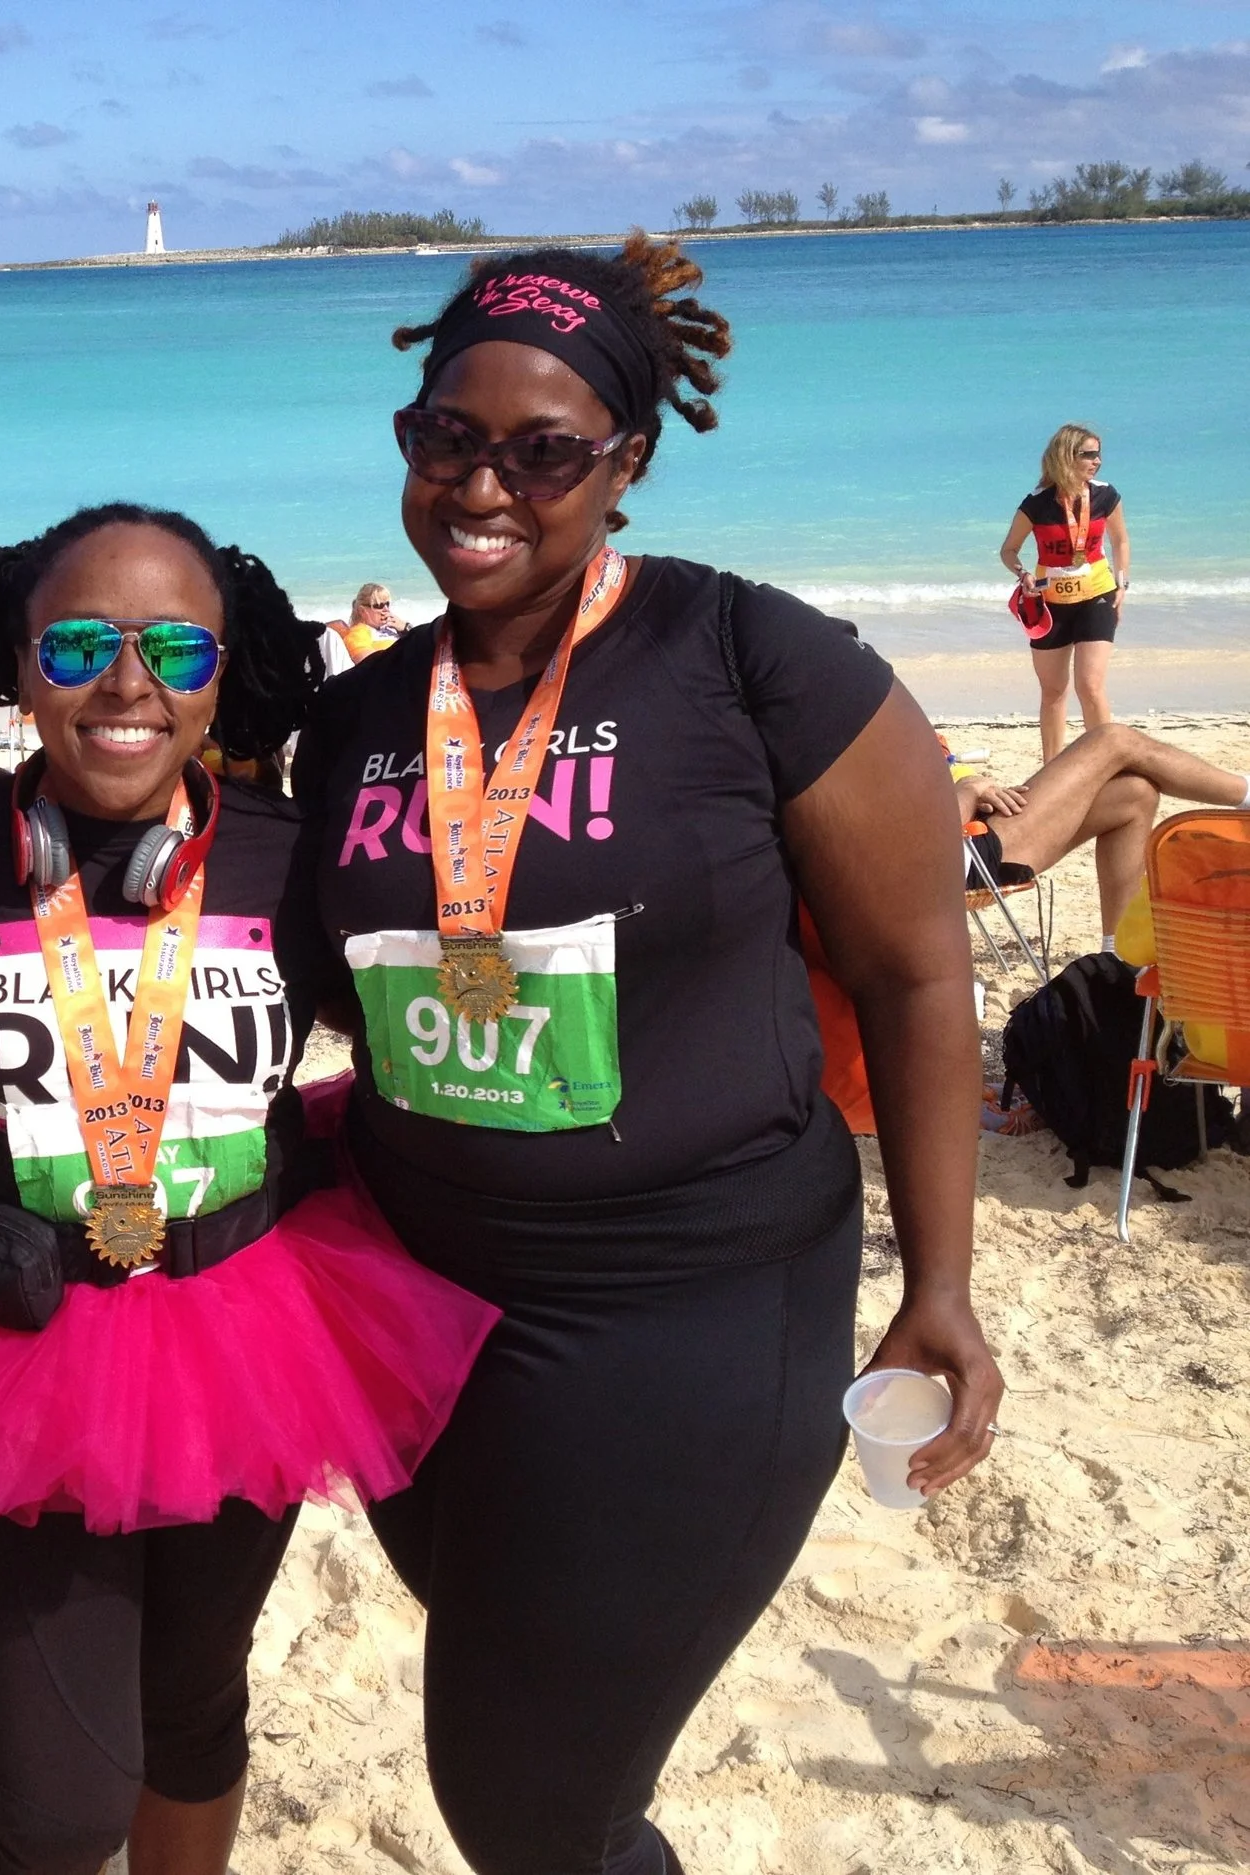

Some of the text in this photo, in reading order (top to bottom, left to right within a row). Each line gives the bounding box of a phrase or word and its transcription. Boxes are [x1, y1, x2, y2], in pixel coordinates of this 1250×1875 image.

[488, 286, 586, 333] Sexy
[1055, 580, 1081, 593] 661
[494, 720, 618, 764] RLS
[445, 754, 454, 790] Assurance
[454, 754, 464, 788] RoyalStar
[486, 787, 531, 802] 2013
[448, 821, 464, 852] John
[441, 899, 486, 918] 2013
[157, 941, 169, 981] Assurance
[440, 941, 499, 950] Sunshine
[62, 955, 75, 993] Assurance
[70, 952, 83, 989] RoyalStar
[190, 966, 282, 1000] IRLS
[141, 1014, 163, 1079] John Bull
[405, 996, 551, 1075] 907
[78, 1025, 105, 1089] John Bull
[431, 1082, 525, 1105] 1.20.2013
[573, 1081, 612, 1091] Emera
[84, 1102, 128, 1123] 2013
[95, 1191, 155, 1200] Sunshine
